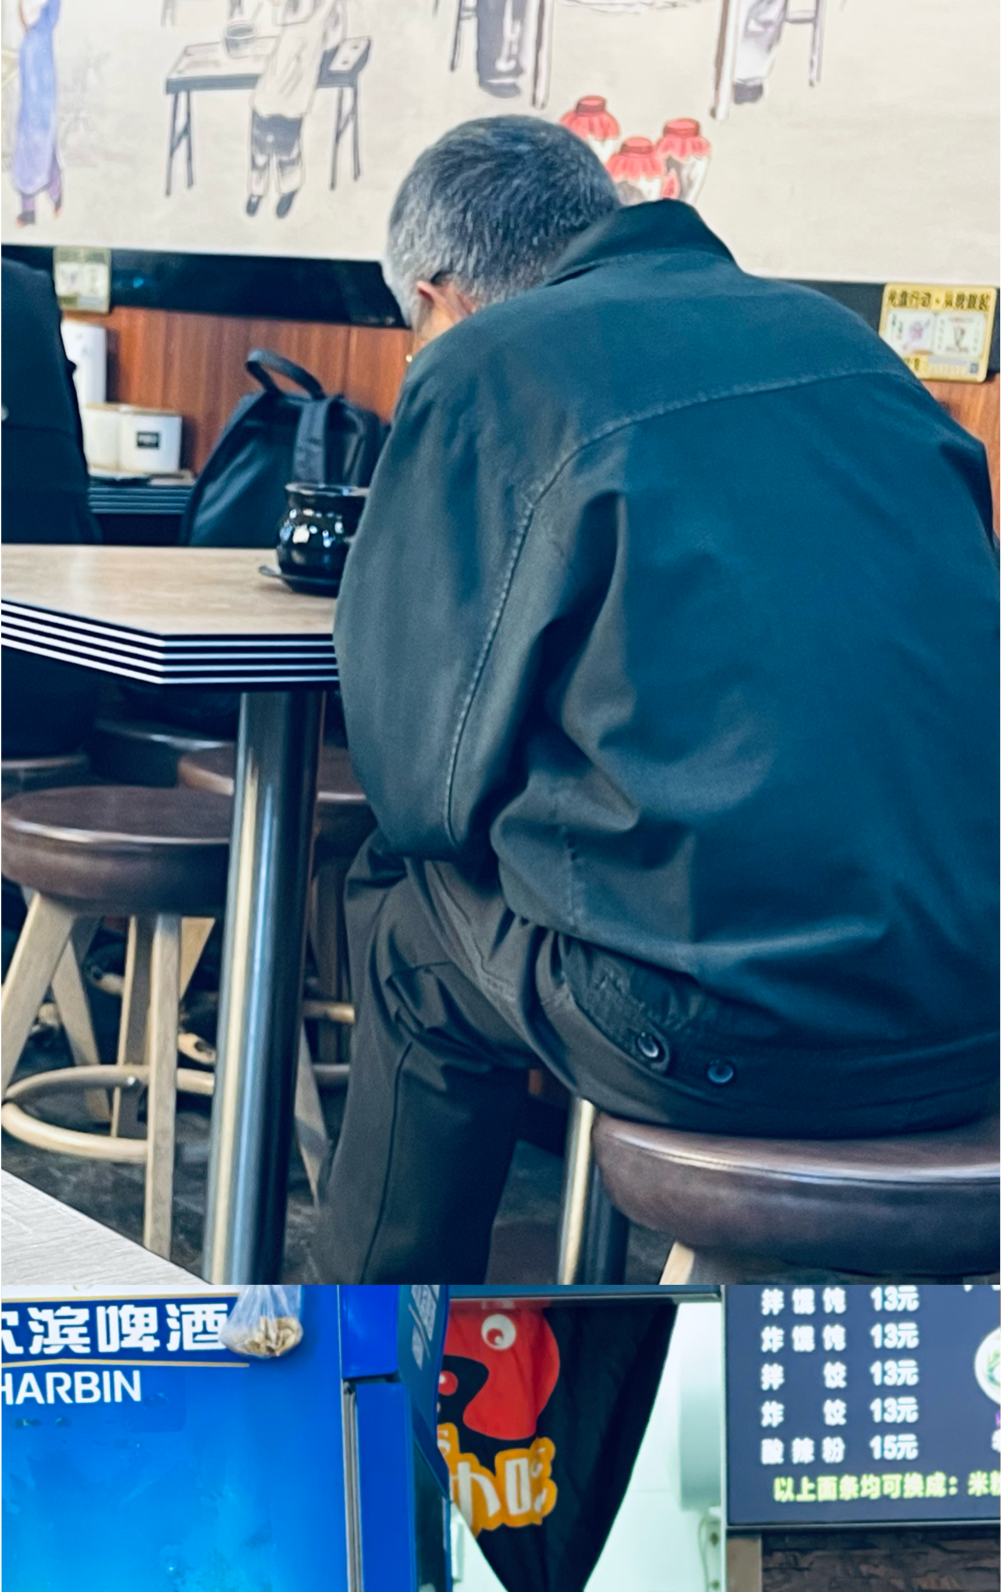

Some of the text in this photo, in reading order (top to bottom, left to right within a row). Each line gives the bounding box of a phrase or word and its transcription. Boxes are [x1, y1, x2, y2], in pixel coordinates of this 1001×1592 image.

[870, 1285, 919, 1311] 13元
[869, 1322, 919, 1348] 13元
[869, 1359, 919, 1386] 13元
[869, 1396, 919, 1423] 13元
[869, 1433, 919, 1460] 15元
